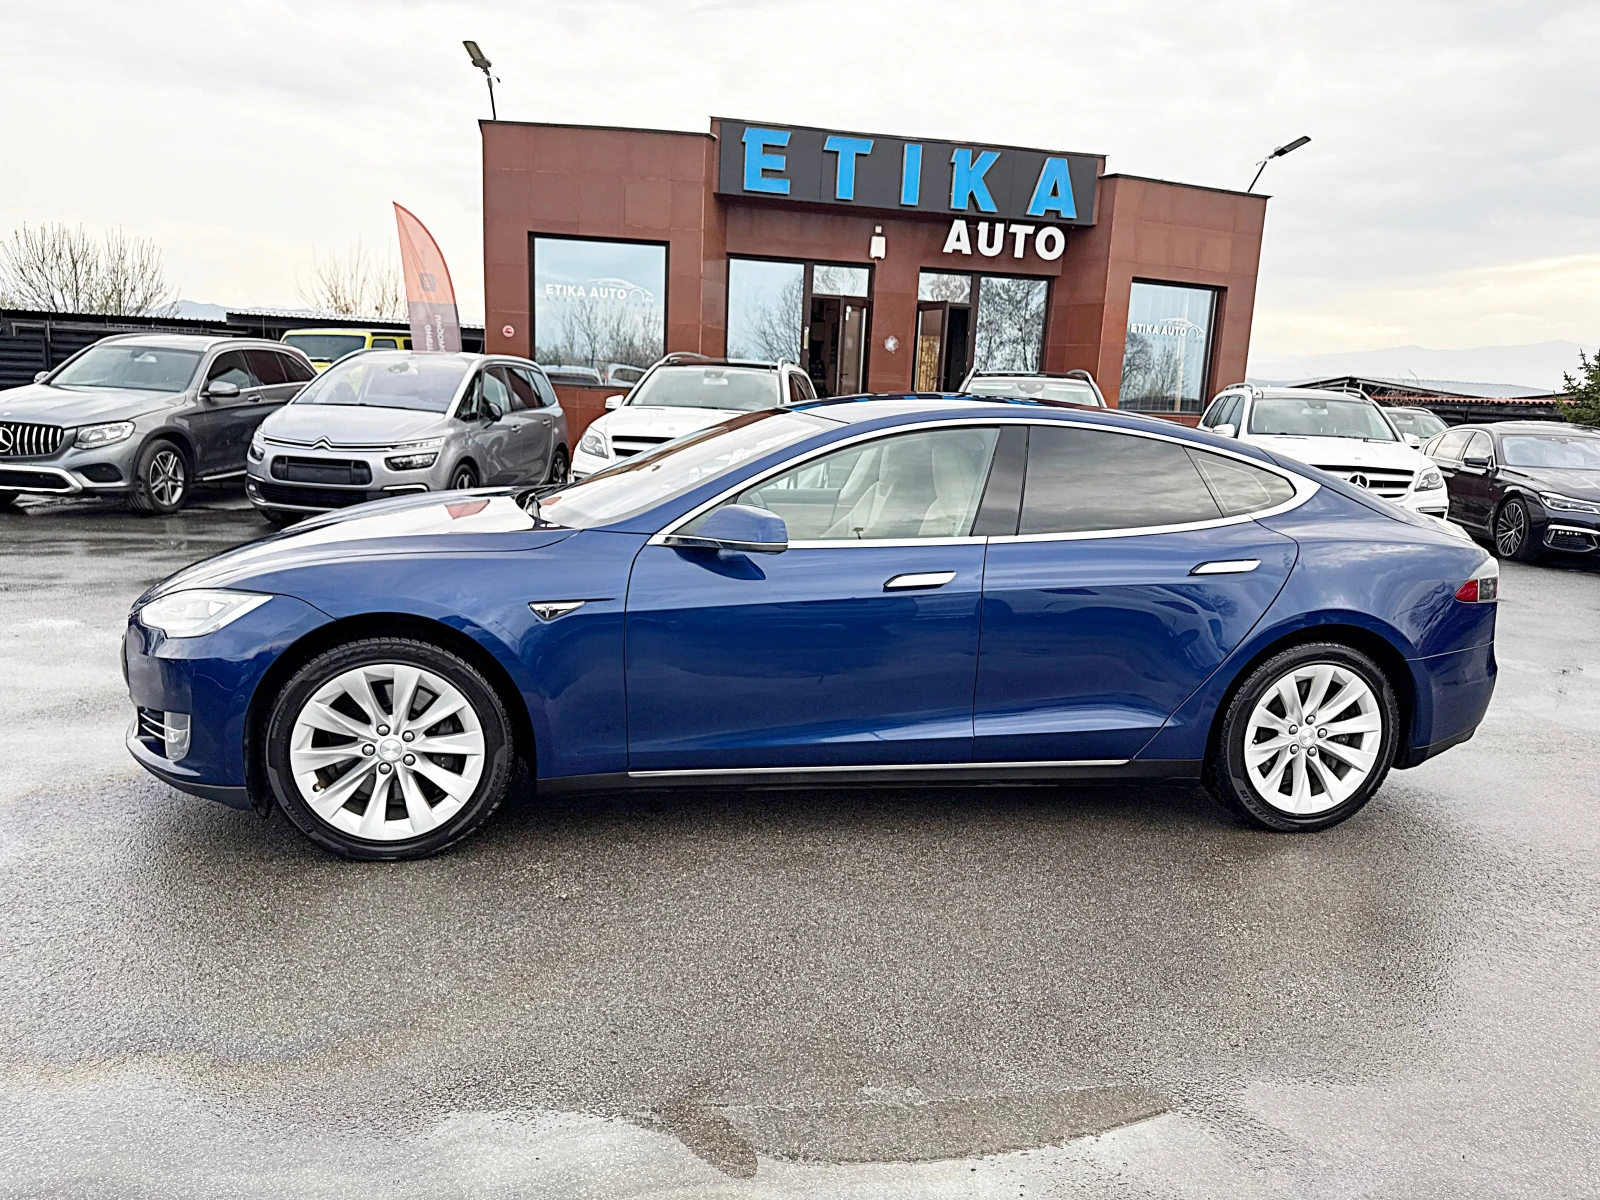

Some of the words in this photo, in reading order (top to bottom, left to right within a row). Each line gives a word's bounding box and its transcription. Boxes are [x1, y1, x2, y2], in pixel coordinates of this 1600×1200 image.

[741, 126, 1077, 219] ETIKA
[942, 218, 1066, 261] AUTO
[545, 283, 586, 298] ETIKA
[589, 286, 627, 301] AUTO
[1130, 322, 1159, 335] ETIKA
[1160, 325, 1187, 337] AUTO
